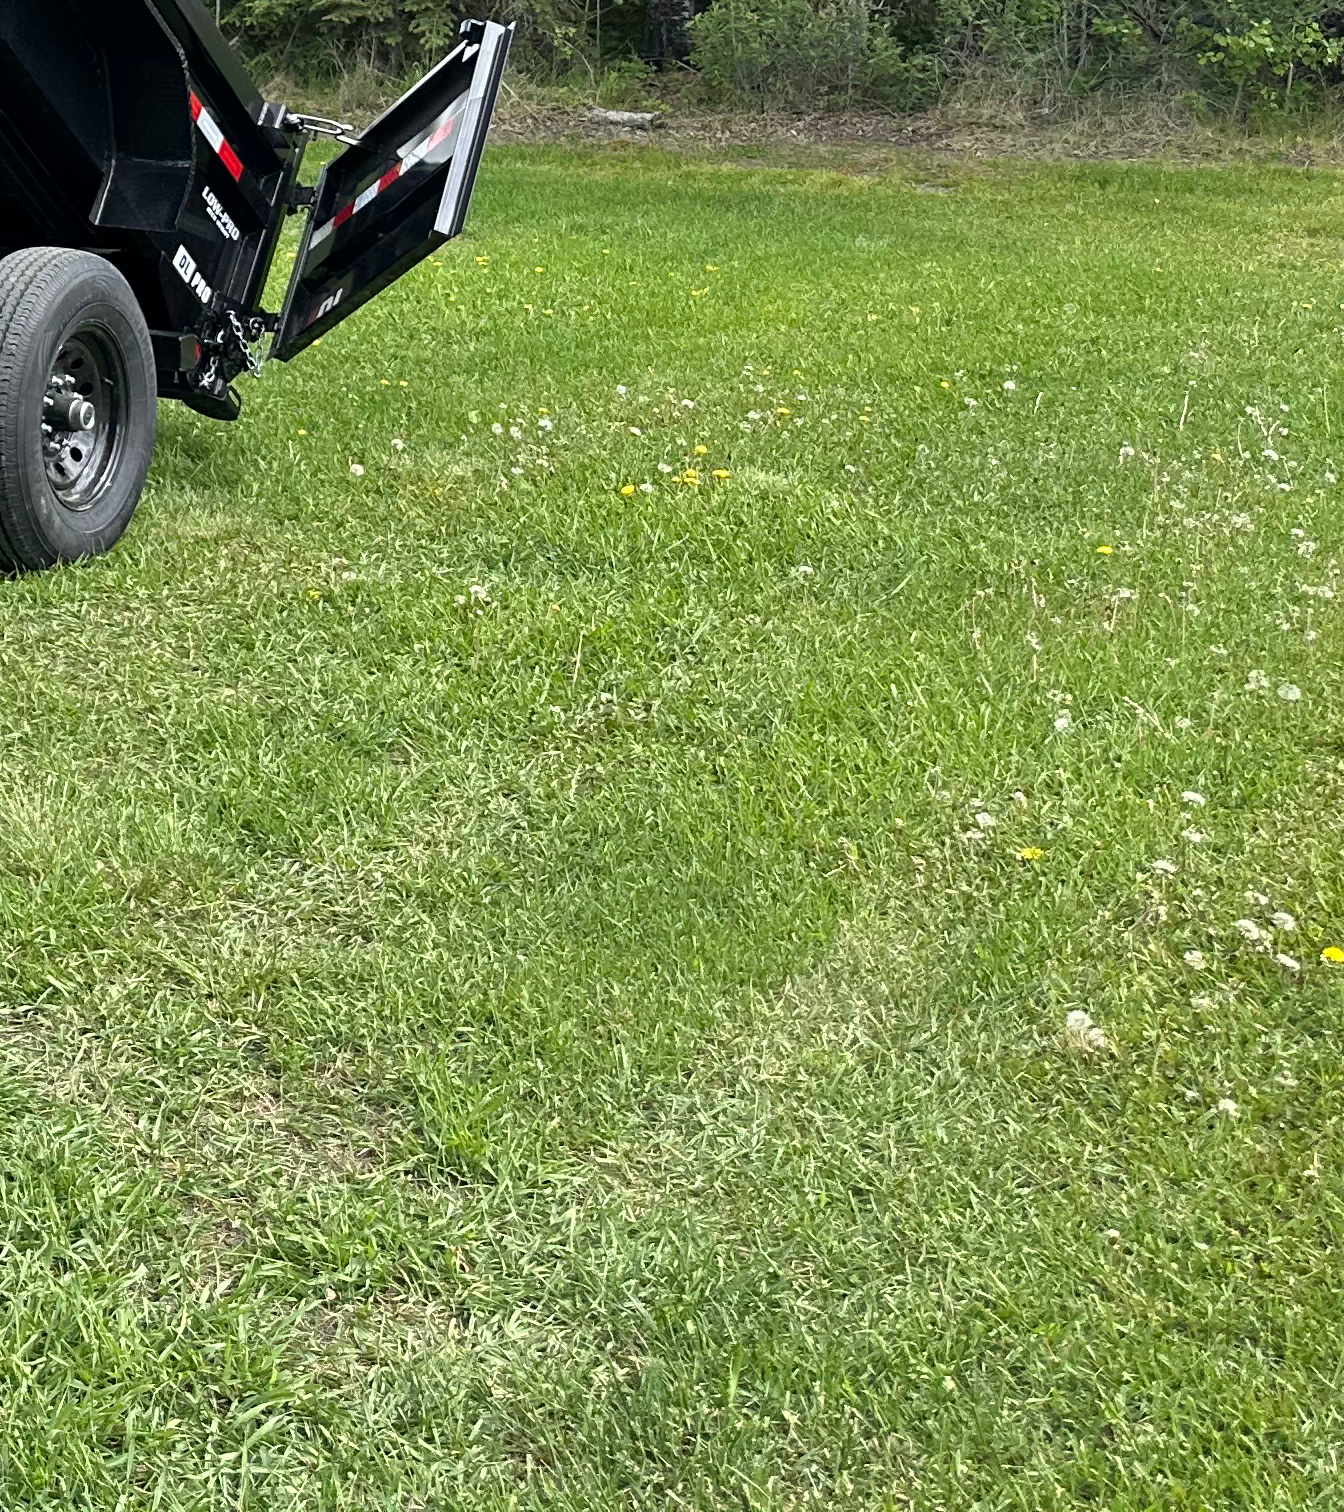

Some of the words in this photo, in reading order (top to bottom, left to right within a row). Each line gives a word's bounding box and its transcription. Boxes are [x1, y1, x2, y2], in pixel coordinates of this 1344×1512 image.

[202, 185, 240, 241] LOW-PRO
[179, 254, 190, 276] DL
[191, 271, 212, 304] PRO
